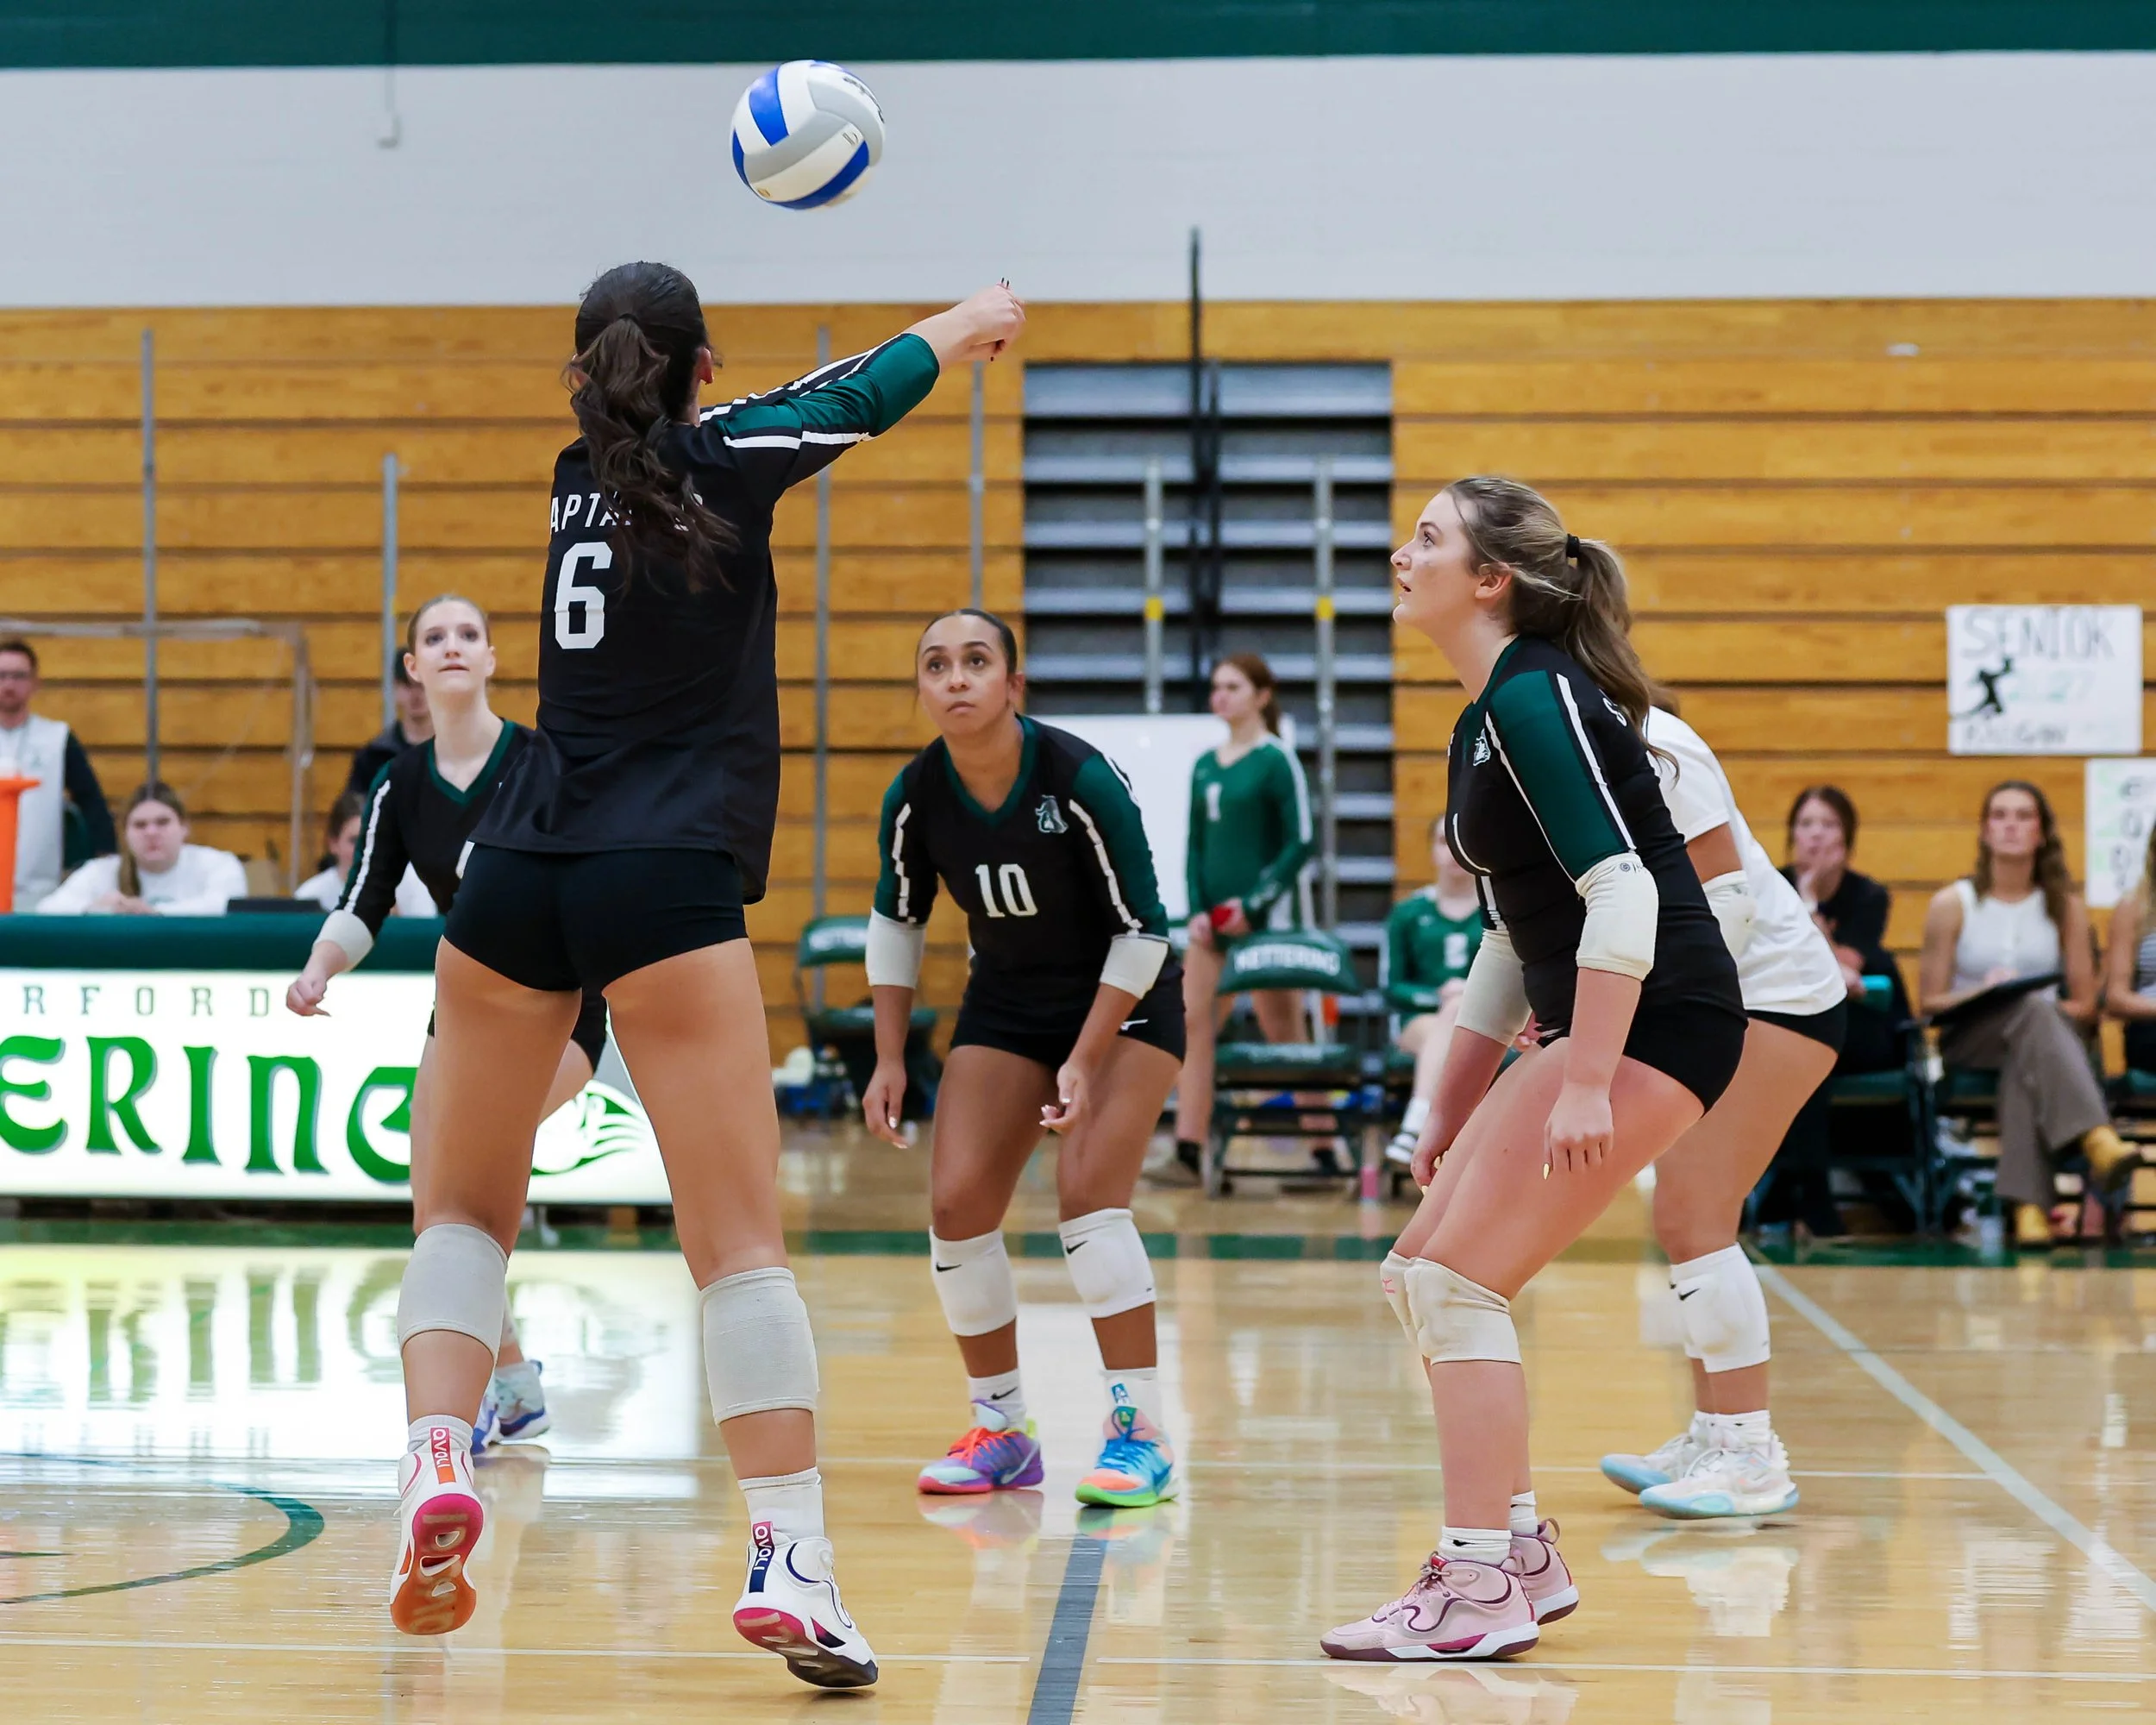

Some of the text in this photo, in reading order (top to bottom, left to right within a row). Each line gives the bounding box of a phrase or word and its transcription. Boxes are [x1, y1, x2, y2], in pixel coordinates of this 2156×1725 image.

[555, 542, 613, 649] 6
[975, 863, 1038, 918] 10
[22, 985, 271, 1017] RFORD
